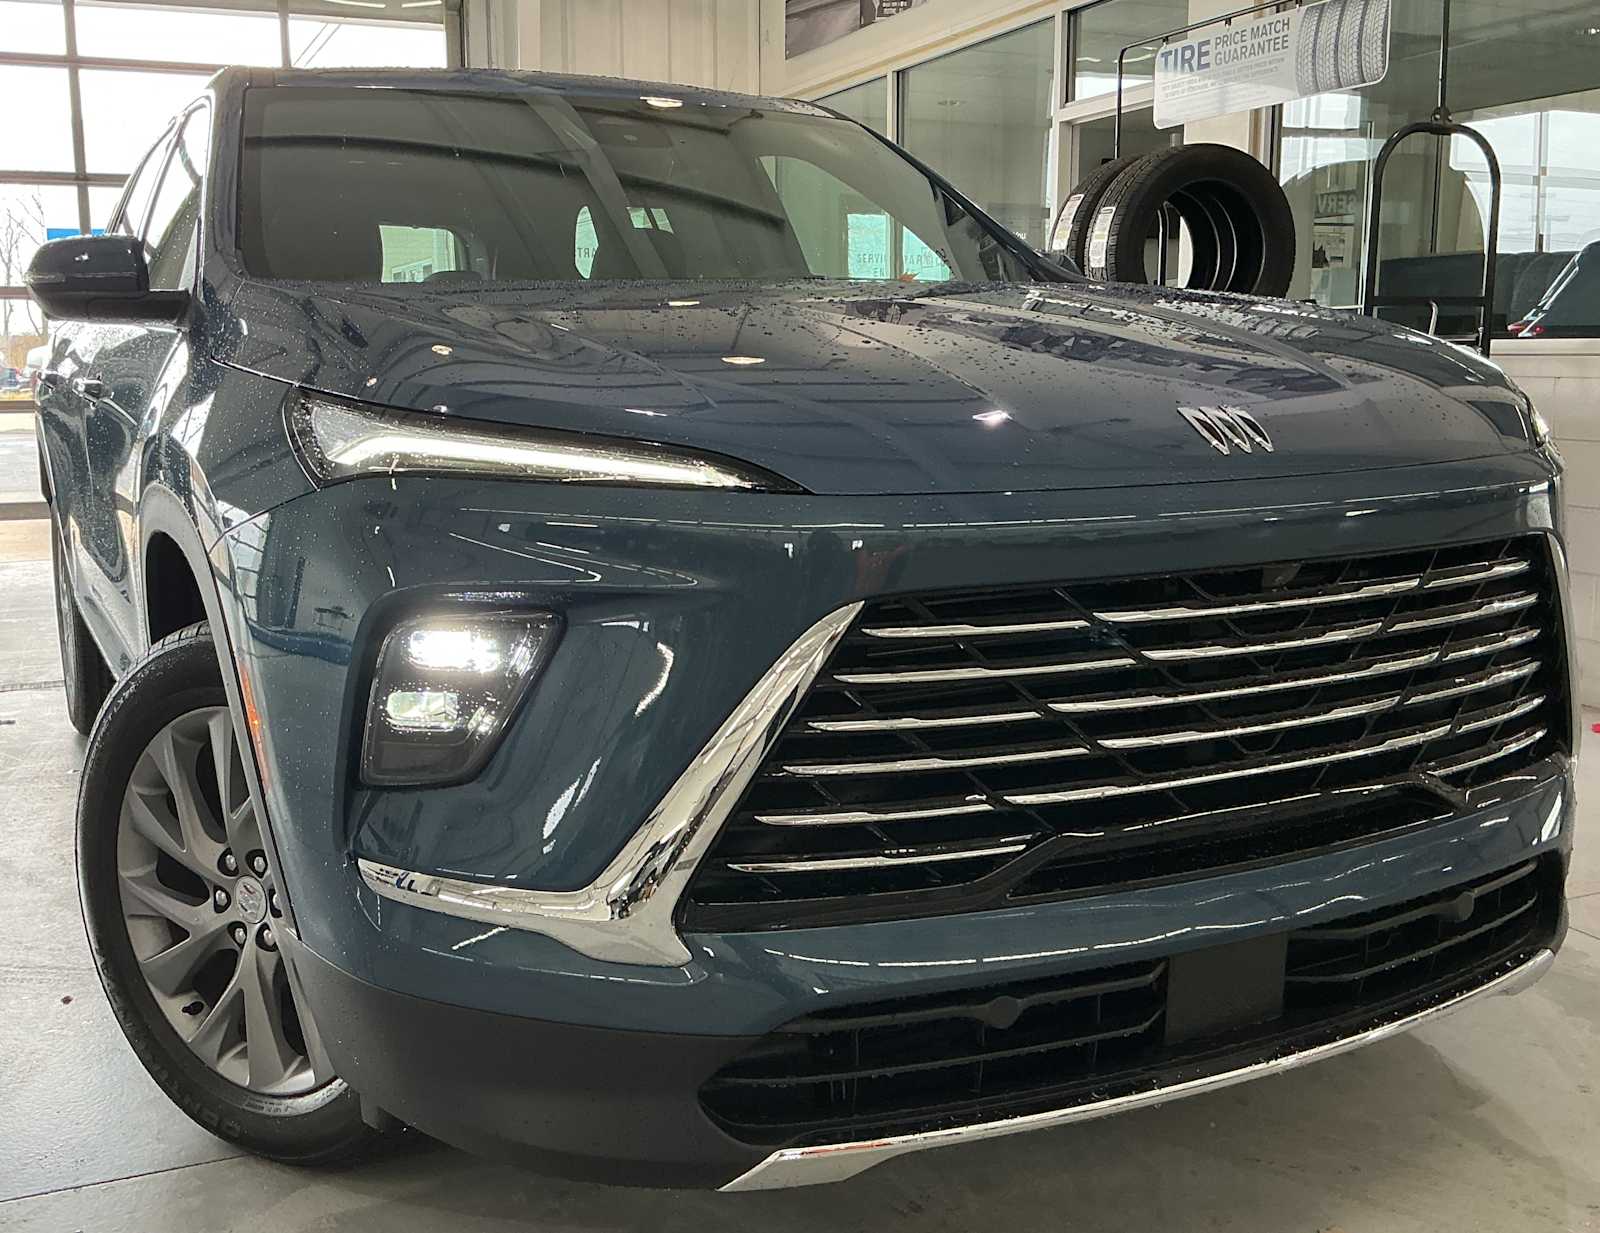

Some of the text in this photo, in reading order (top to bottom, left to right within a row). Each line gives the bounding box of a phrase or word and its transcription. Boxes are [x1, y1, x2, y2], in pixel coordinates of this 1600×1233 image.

[1215, 17, 1290, 50] PRICE MATCH
[1160, 40, 1211, 73] TIRE
[1215, 34, 1290, 67] GUARANTEE
